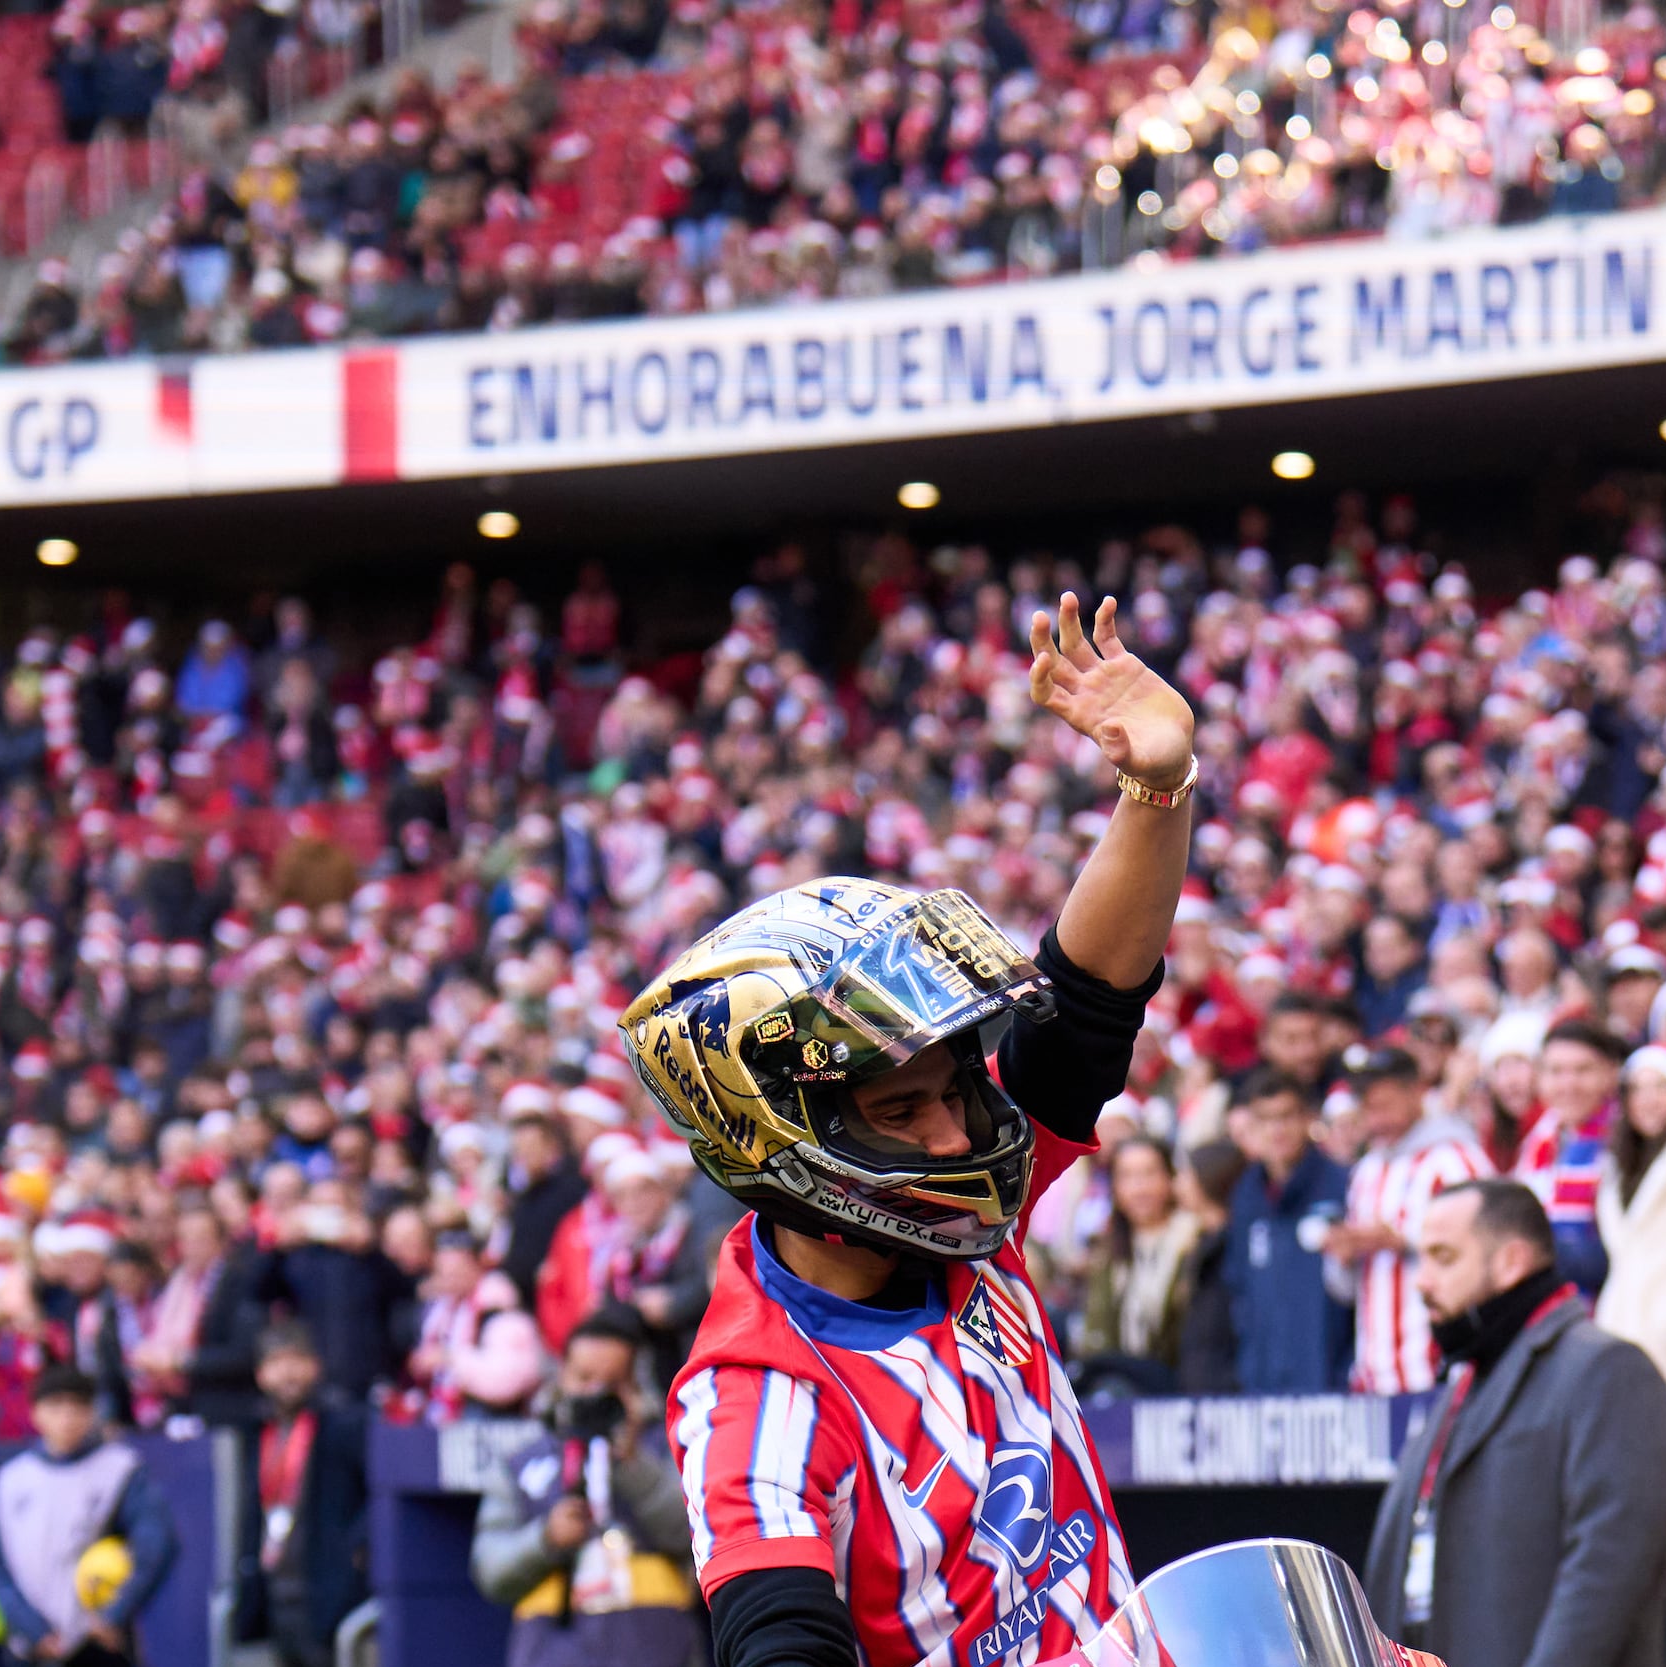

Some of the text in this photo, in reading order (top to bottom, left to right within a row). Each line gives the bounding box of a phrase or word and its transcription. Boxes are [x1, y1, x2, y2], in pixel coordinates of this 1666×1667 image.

[467, 312, 1064, 450] ENHORABUENA,
[1095, 284, 1321, 394] JORGE
[8, 399, 100, 481] GP
[859, 908, 908, 948] GIVES
[941, 996, 1004, 1032] Breathe Right
[653, 1026, 694, 1104] Red
[841, 1197, 927, 1240] kyrrex
[933, 1234, 958, 1247] SPORT
[1048, 1518, 1094, 1579] AIR
[975, 1587, 1049, 1666] RIYAD
